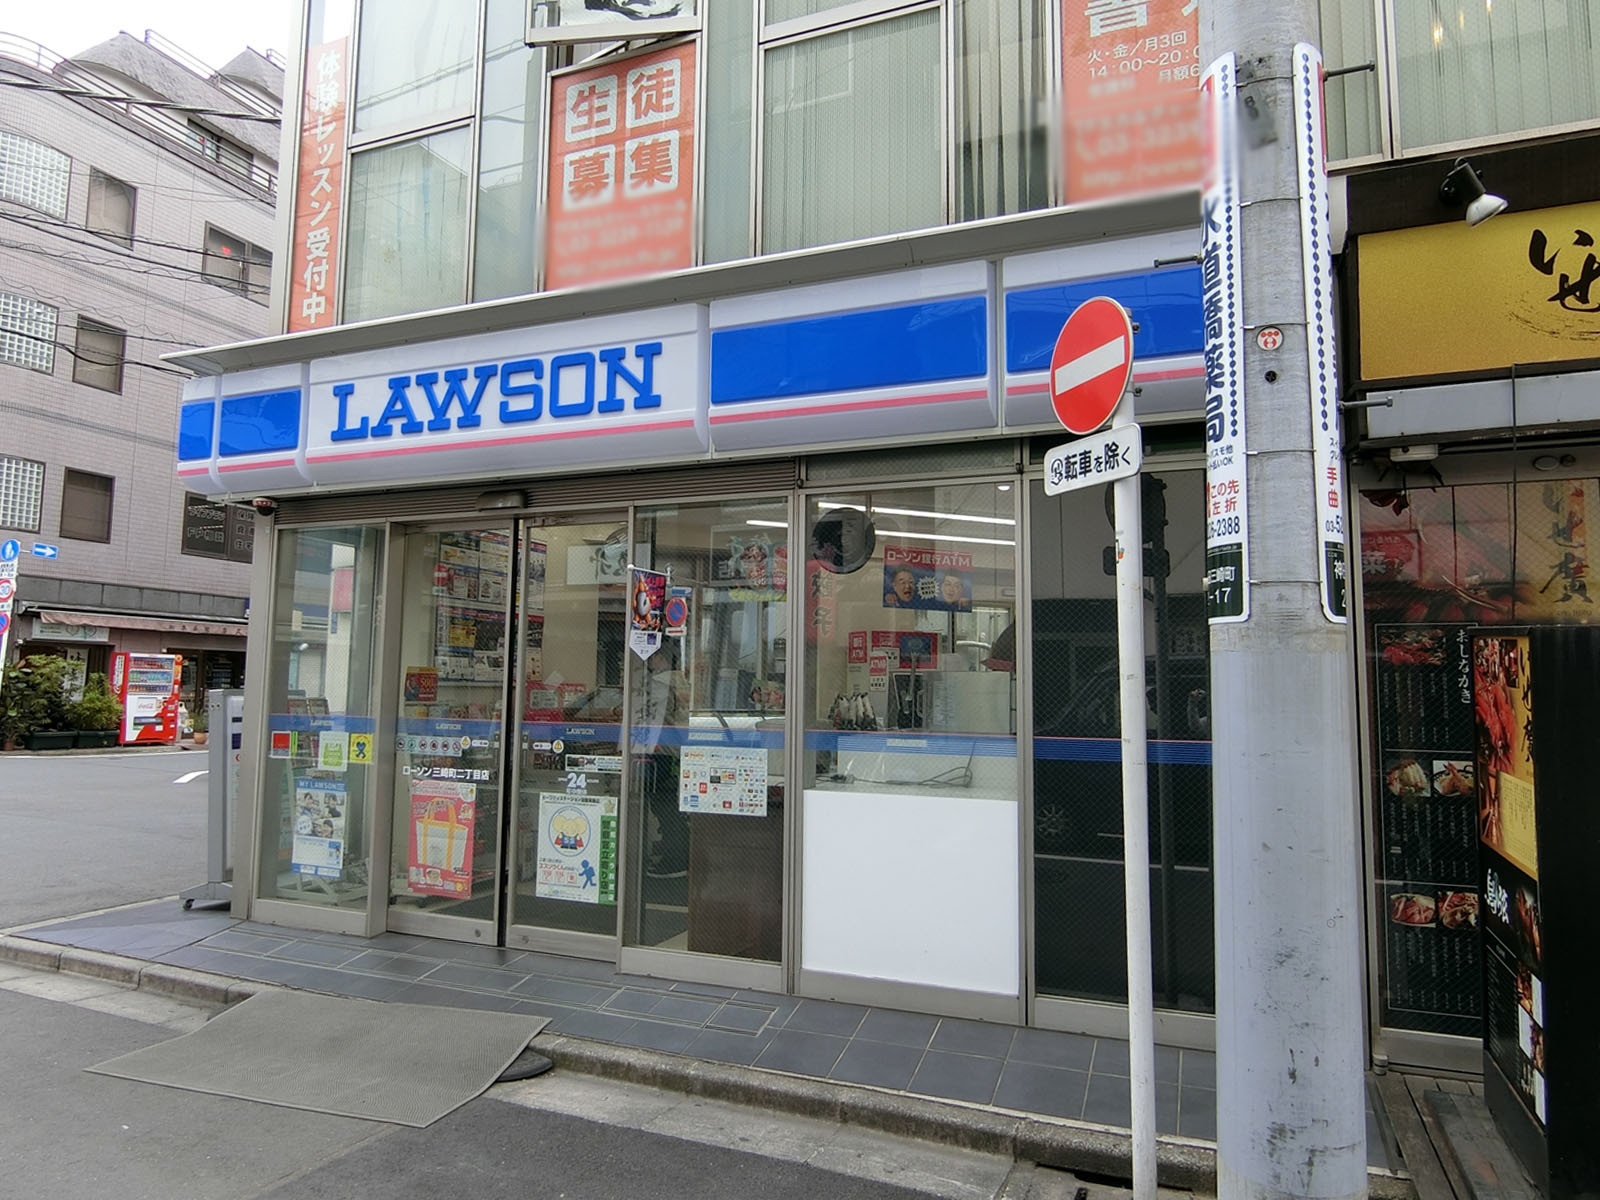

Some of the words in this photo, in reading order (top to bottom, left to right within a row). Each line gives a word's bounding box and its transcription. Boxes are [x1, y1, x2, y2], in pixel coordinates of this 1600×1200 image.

[569, 66, 676, 138] 生徒
[567, 133, 675, 204] 募集
[302, 52, 340, 324] 体験レッスン受付中
[330, 341, 663, 442] LAWSON
[1211, 480, 1240, 499] この先
[887, 550, 971, 567] ローソン銀行ATM
[1208, 587, 1232, 606] -17
[566, 727, 596, 736] LAWSON
[567, 772, 587, 789] 24
